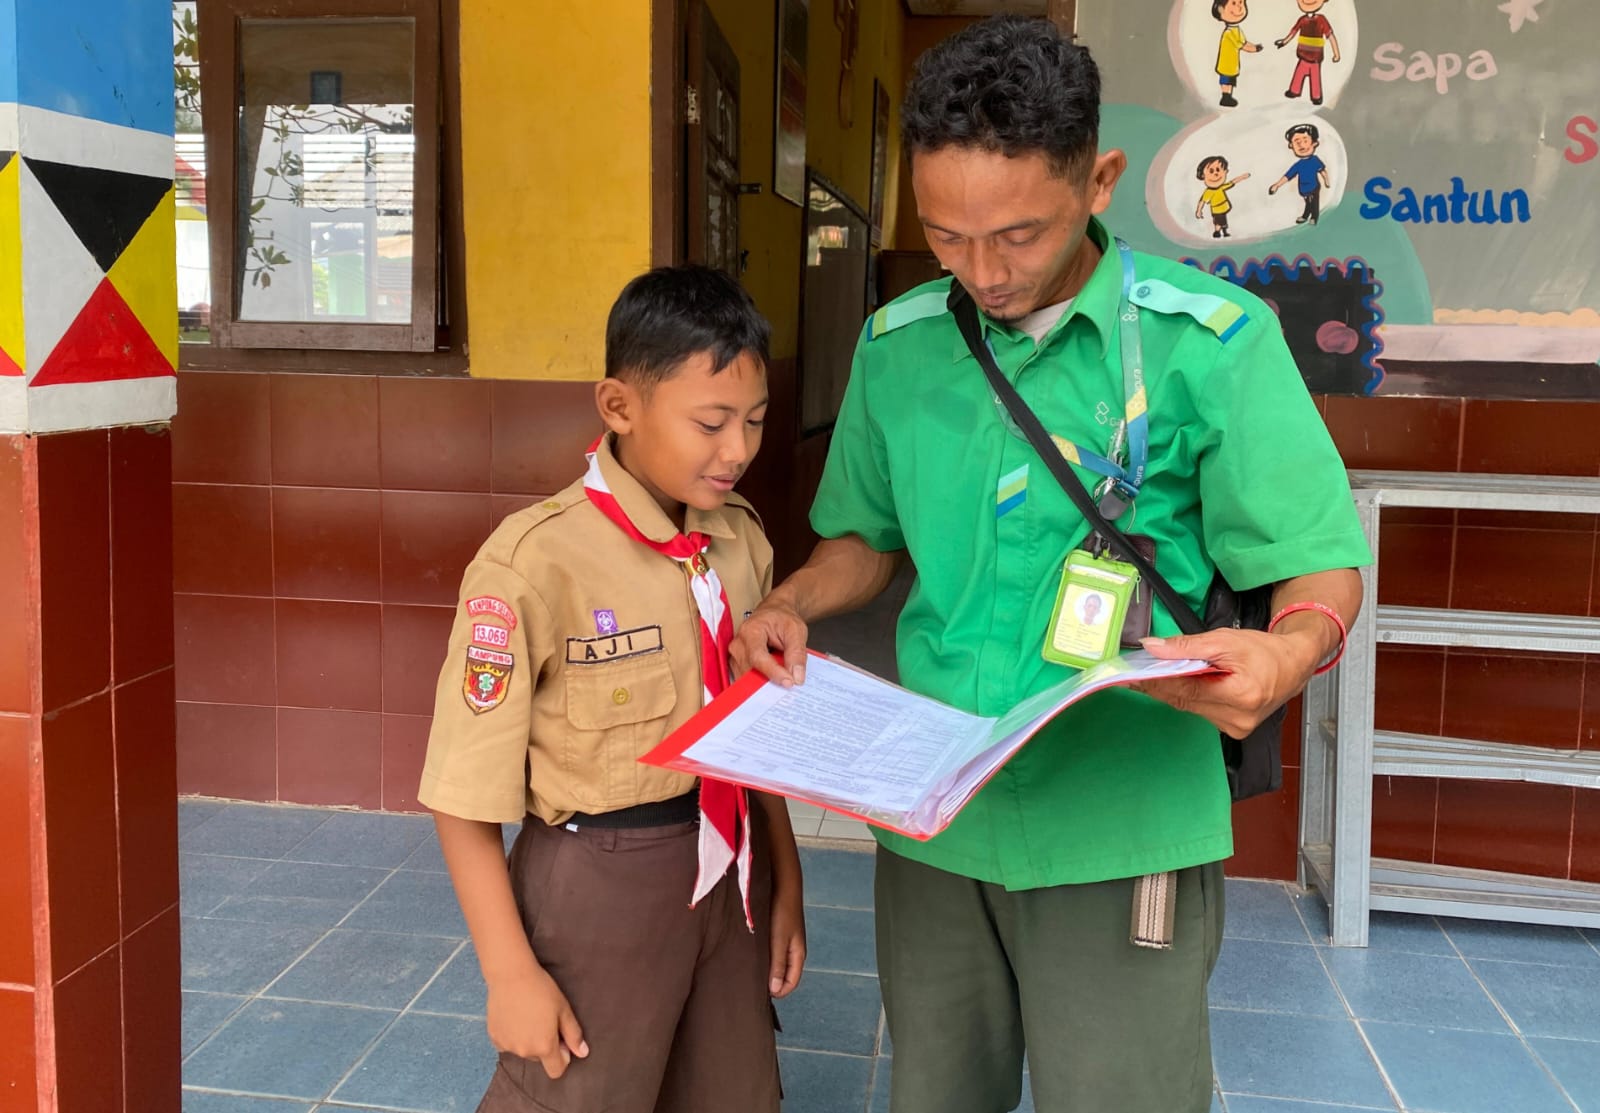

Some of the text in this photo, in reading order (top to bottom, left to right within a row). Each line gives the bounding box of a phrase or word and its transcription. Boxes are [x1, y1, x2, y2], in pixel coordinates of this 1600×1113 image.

[1370, 42, 1498, 94] Sapa
[1360, 176, 1531, 224] Santun
[476, 627, 506, 644] 13.069
[585, 635, 632, 660] AJI
[469, 648, 511, 664] LAMPUNG
